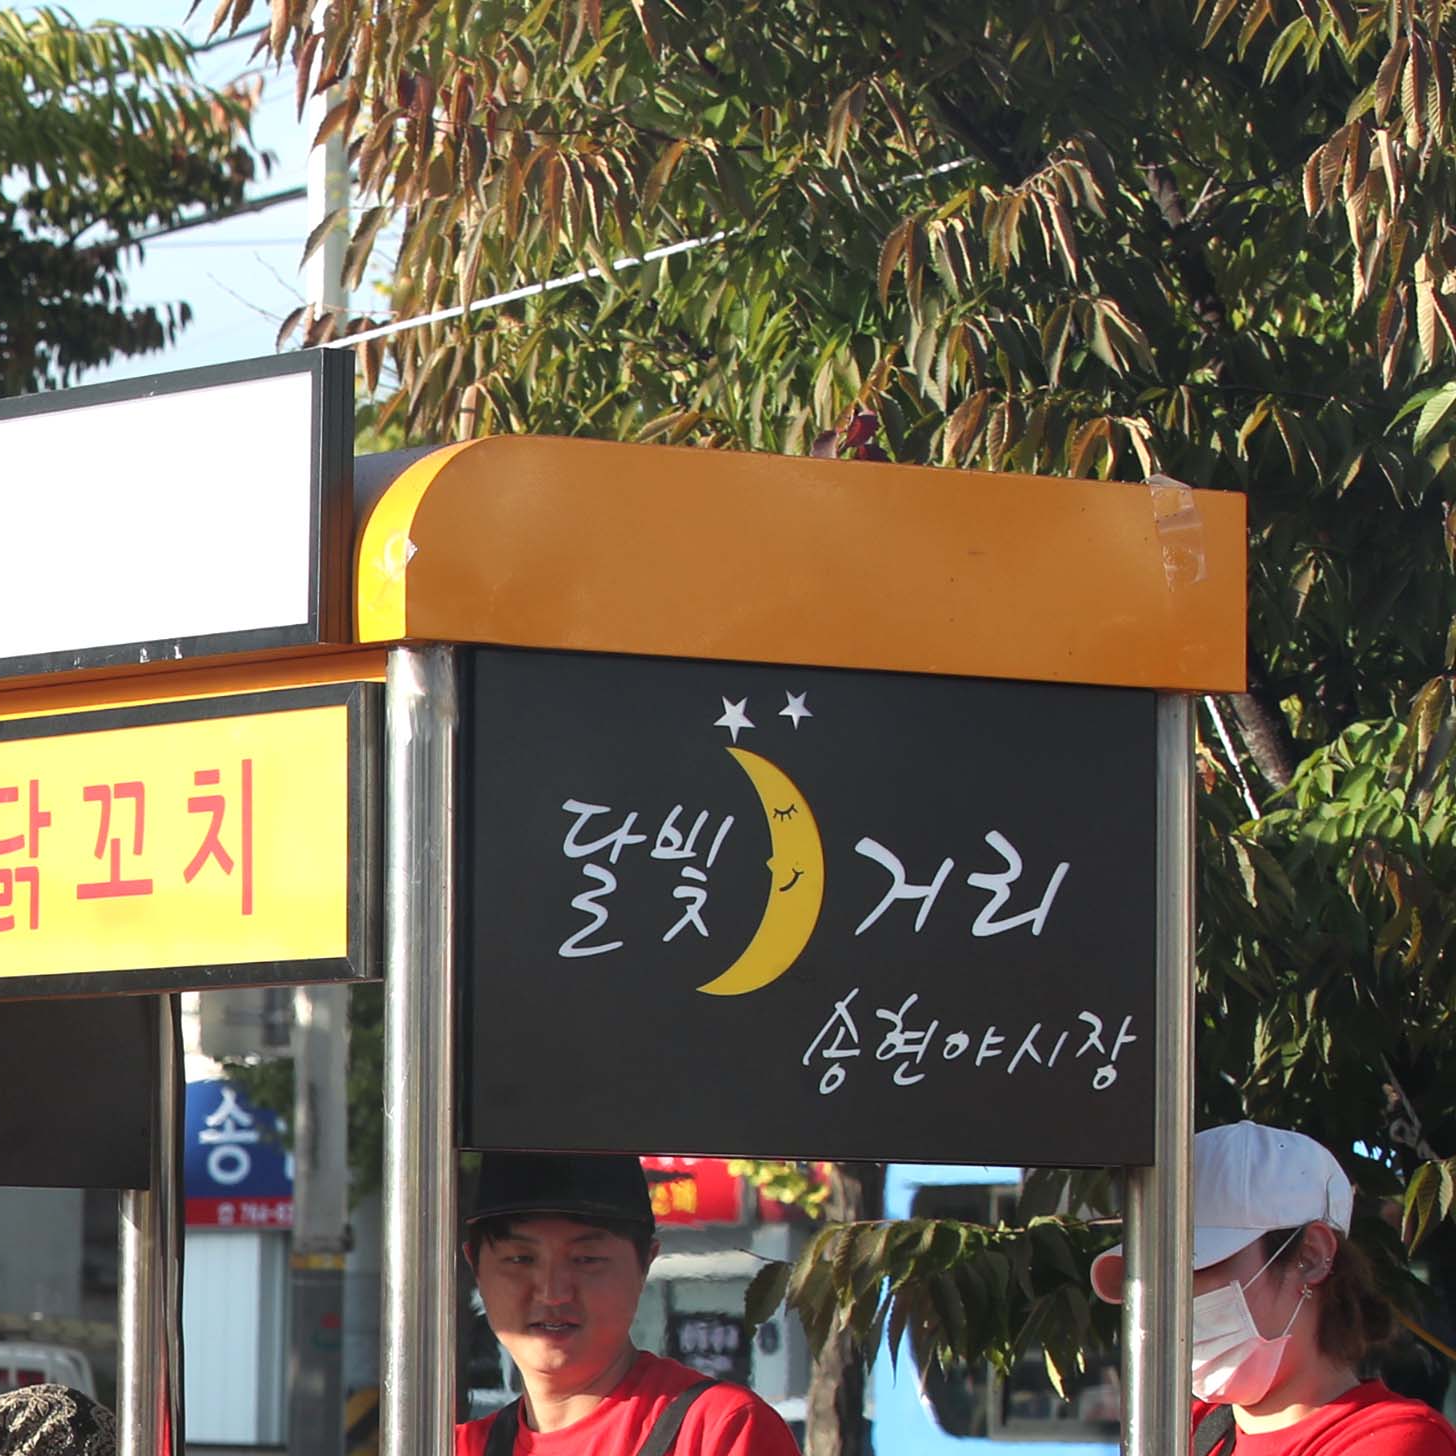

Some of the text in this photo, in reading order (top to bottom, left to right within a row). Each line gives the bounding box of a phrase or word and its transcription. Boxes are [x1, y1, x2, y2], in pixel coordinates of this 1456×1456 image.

[558, 799, 1070, 958] 달빛 거리
[802, 987, 1136, 1095] 송현야시장
